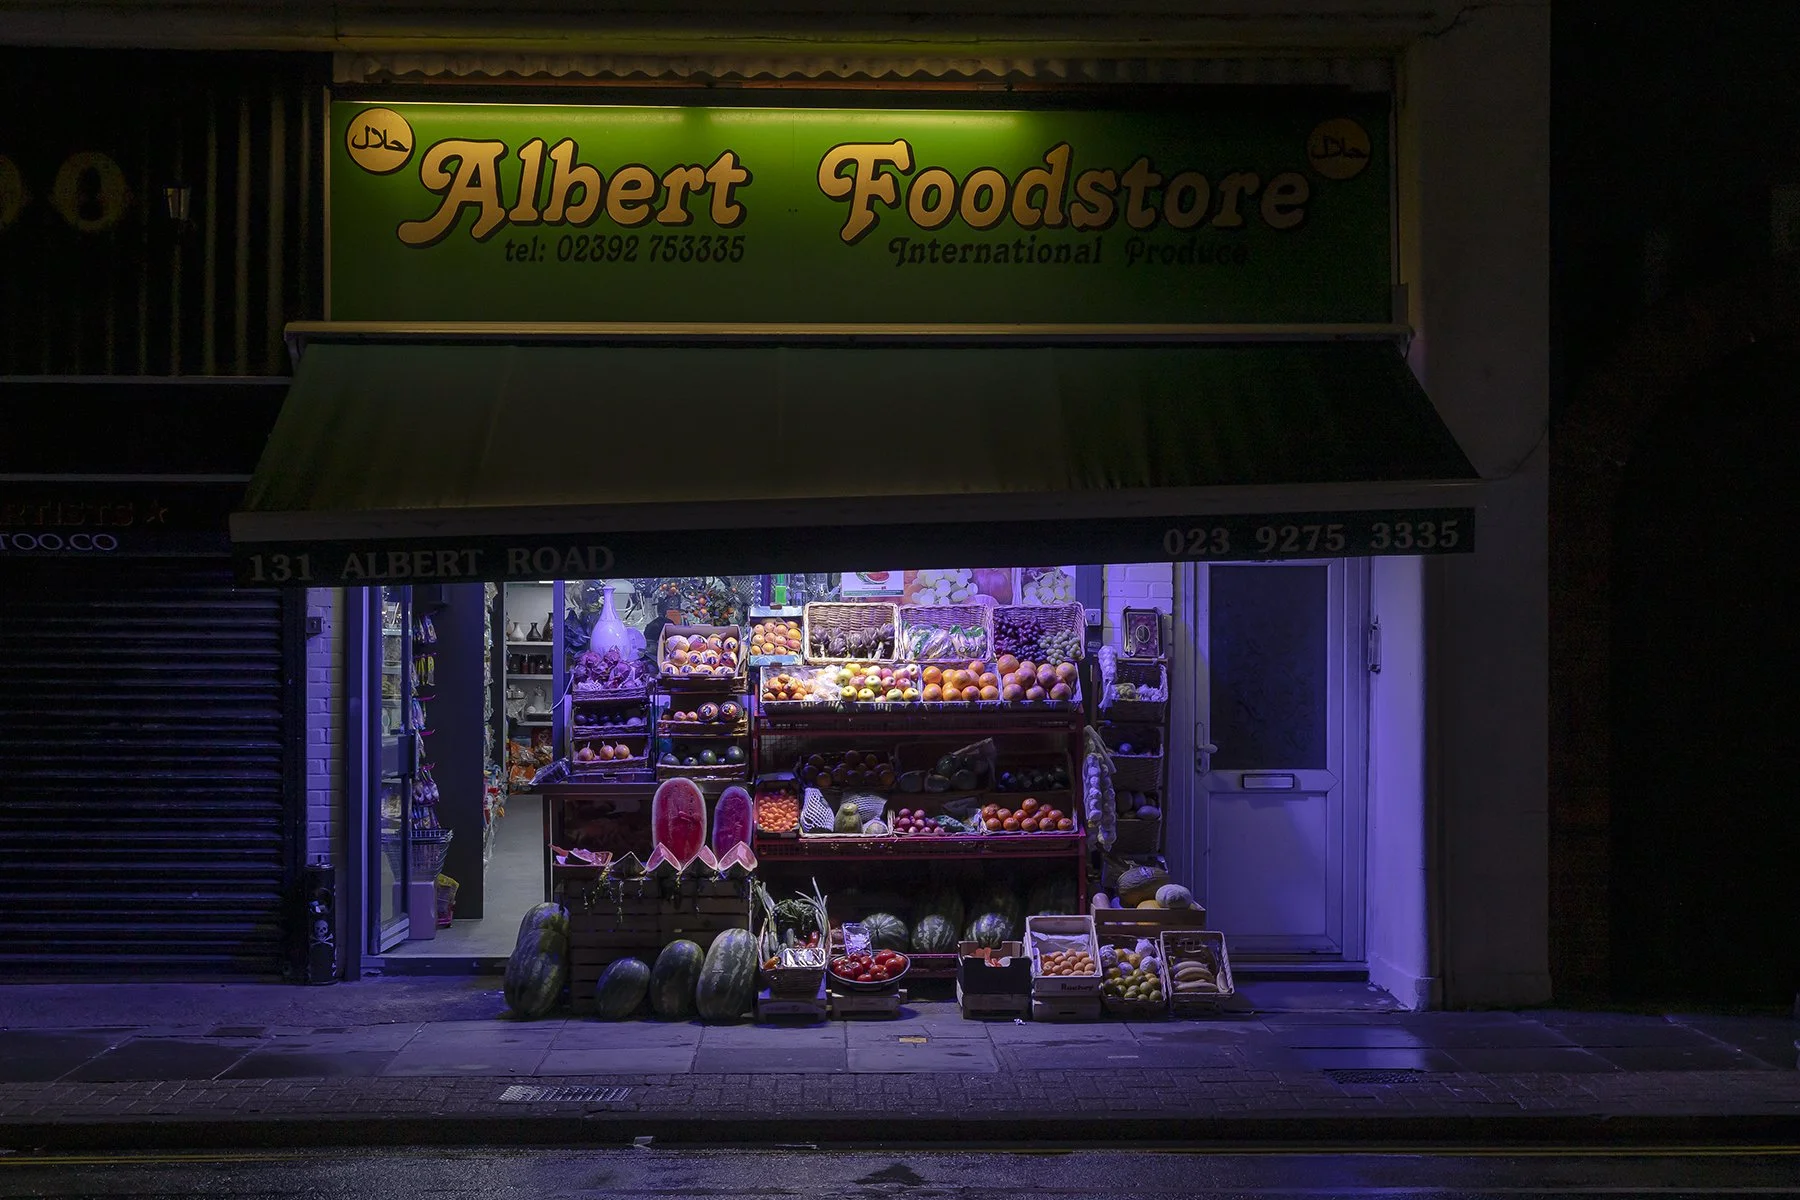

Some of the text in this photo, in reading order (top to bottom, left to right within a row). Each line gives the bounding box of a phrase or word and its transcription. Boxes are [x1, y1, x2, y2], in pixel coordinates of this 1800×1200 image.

[351, 125, 409, 152] حلال
[396, 137, 1310, 249] Albert Foodstore
[505, 234, 746, 263] tel: 02392 753335
[888, 235, 1248, 267] International Produce
[1162, 519, 1459, 556] 023 9275 3335
[249, 545, 615, 582] 131 ALBERT ROAD
